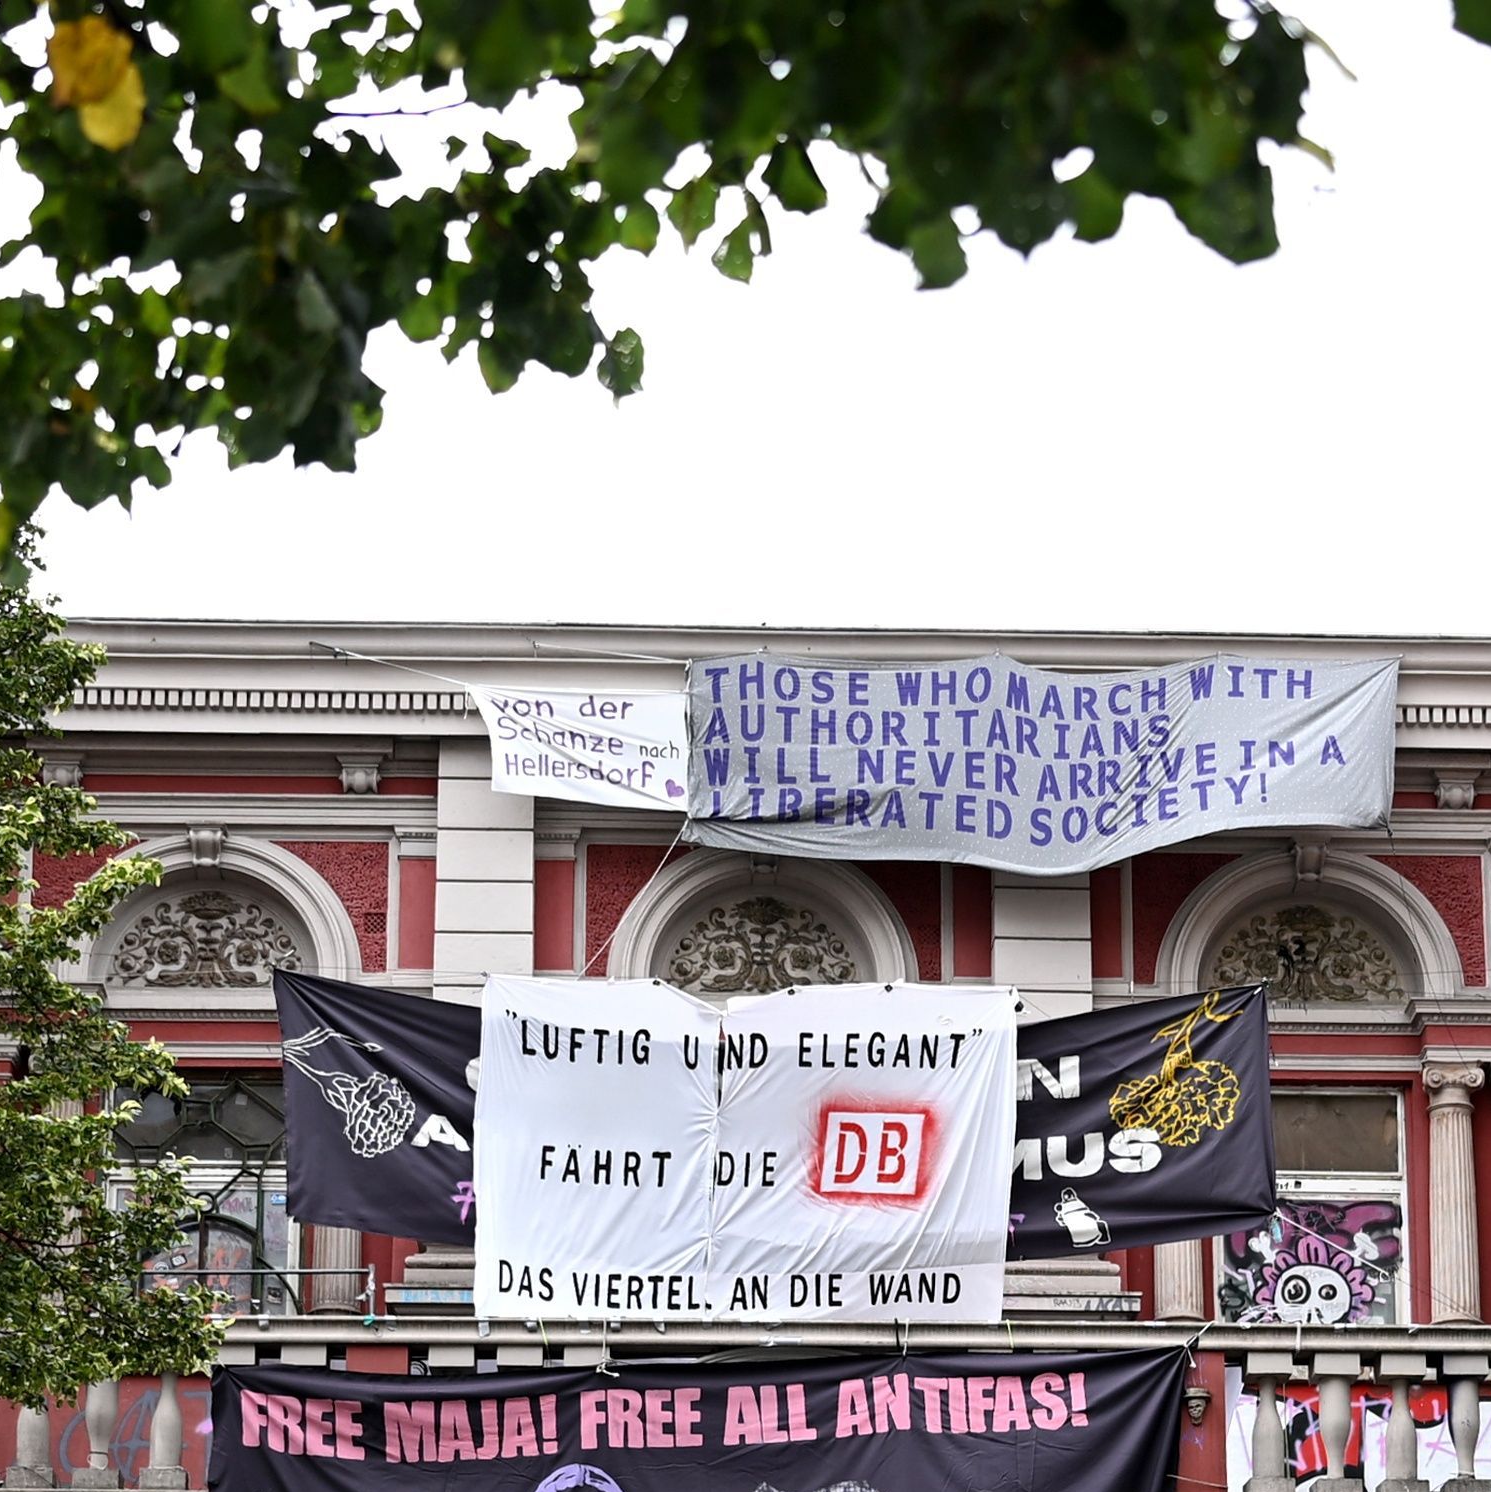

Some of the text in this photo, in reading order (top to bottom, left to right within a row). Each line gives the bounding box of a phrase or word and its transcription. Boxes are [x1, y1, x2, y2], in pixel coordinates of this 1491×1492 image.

[491, 695, 634, 720] von der
[705, 661, 1313, 721] THOSE WHO MARCH WITH
[497, 717, 680, 760] Schanze nach
[705, 704, 1171, 760] AUTHORITARIANS
[505, 752, 656, 789] Hellersdorf
[705, 735, 1346, 802] WILL NEVER ARRIVE IN A
[708, 772, 1268, 847] LIBERATED SOCIETY!
[683, 1028, 771, 1072] UND
[539, 1120, 910, 1190] FÄHRT DIE DB
[496, 1258, 555, 1305] DAS
[730, 1274, 765, 1312] AN
[788, 1271, 844, 1309] DIE
[867, 1269, 963, 1307] WAND
[239, 1371, 1090, 1464] FREE MAJA! FREE ALL ANTIFAS!
